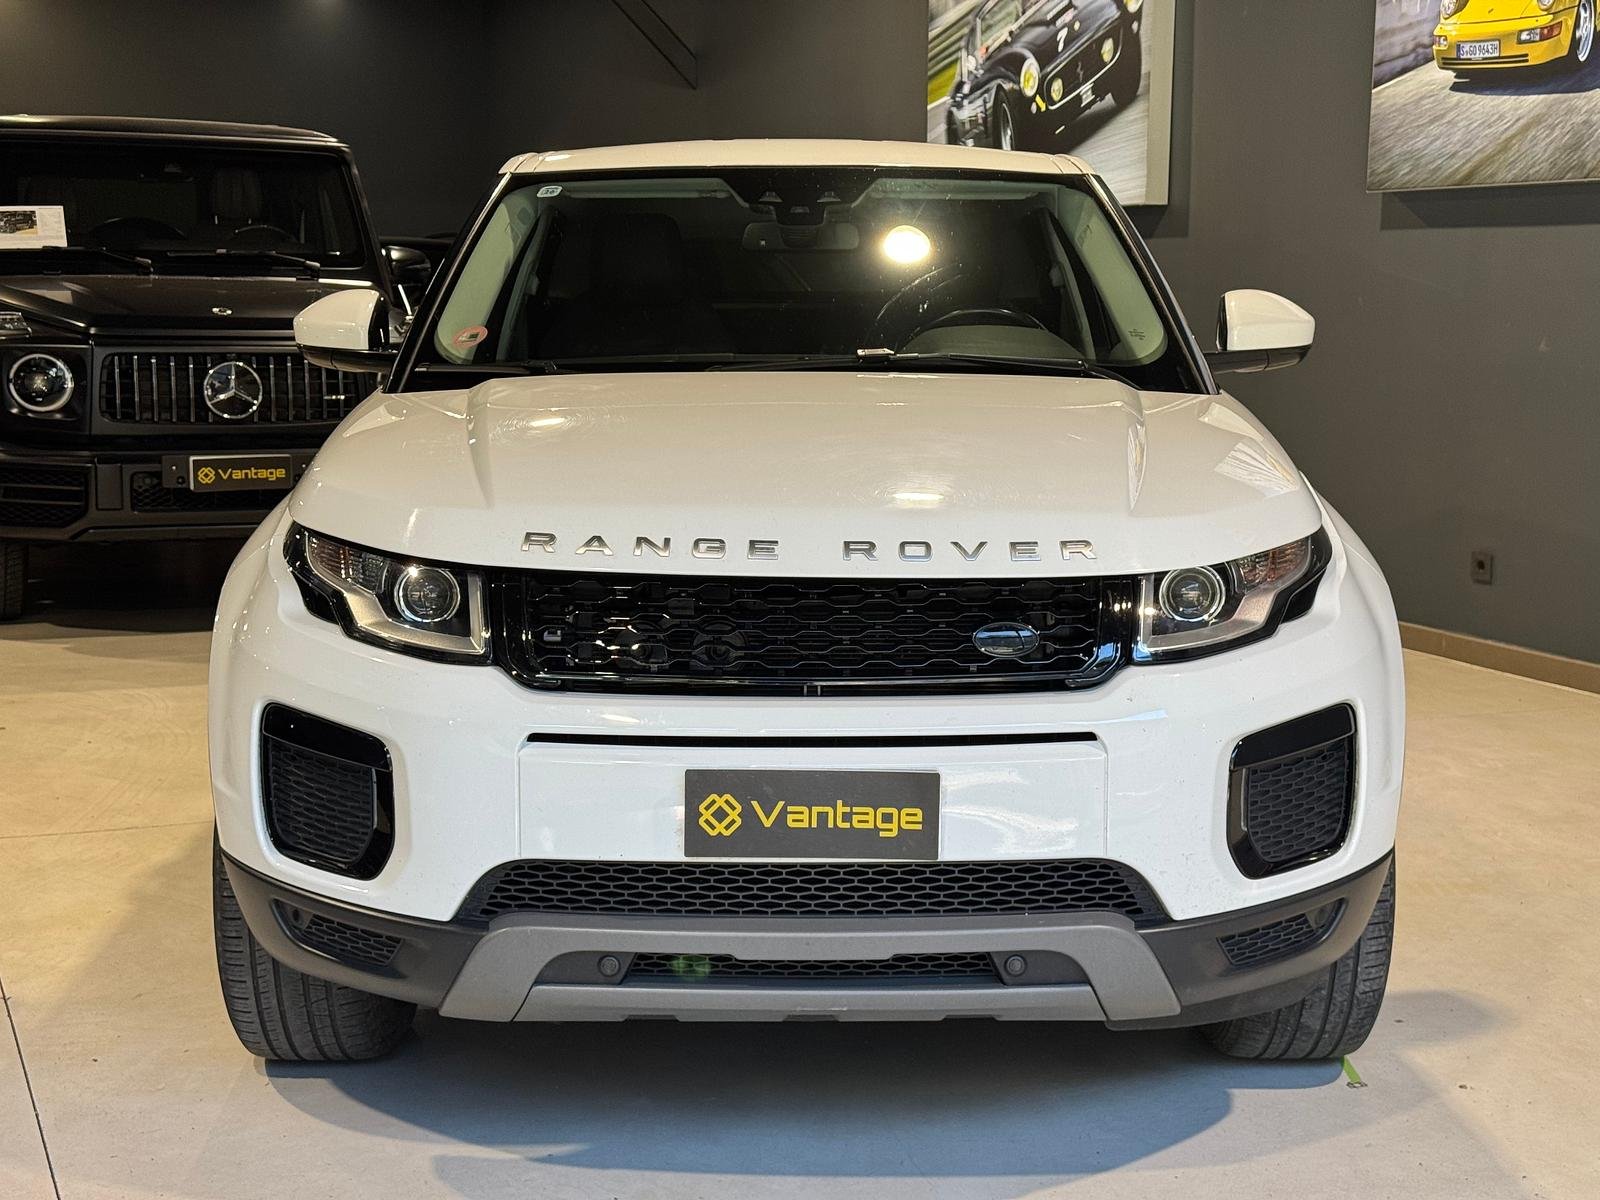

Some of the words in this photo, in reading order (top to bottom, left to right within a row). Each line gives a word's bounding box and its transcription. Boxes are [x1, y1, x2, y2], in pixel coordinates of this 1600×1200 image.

[218, 467, 286, 481] Vantage
[520, 531, 779, 560] RANGE
[842, 539, 1098, 561] ROVER
[750, 799, 923, 838] Vantage
